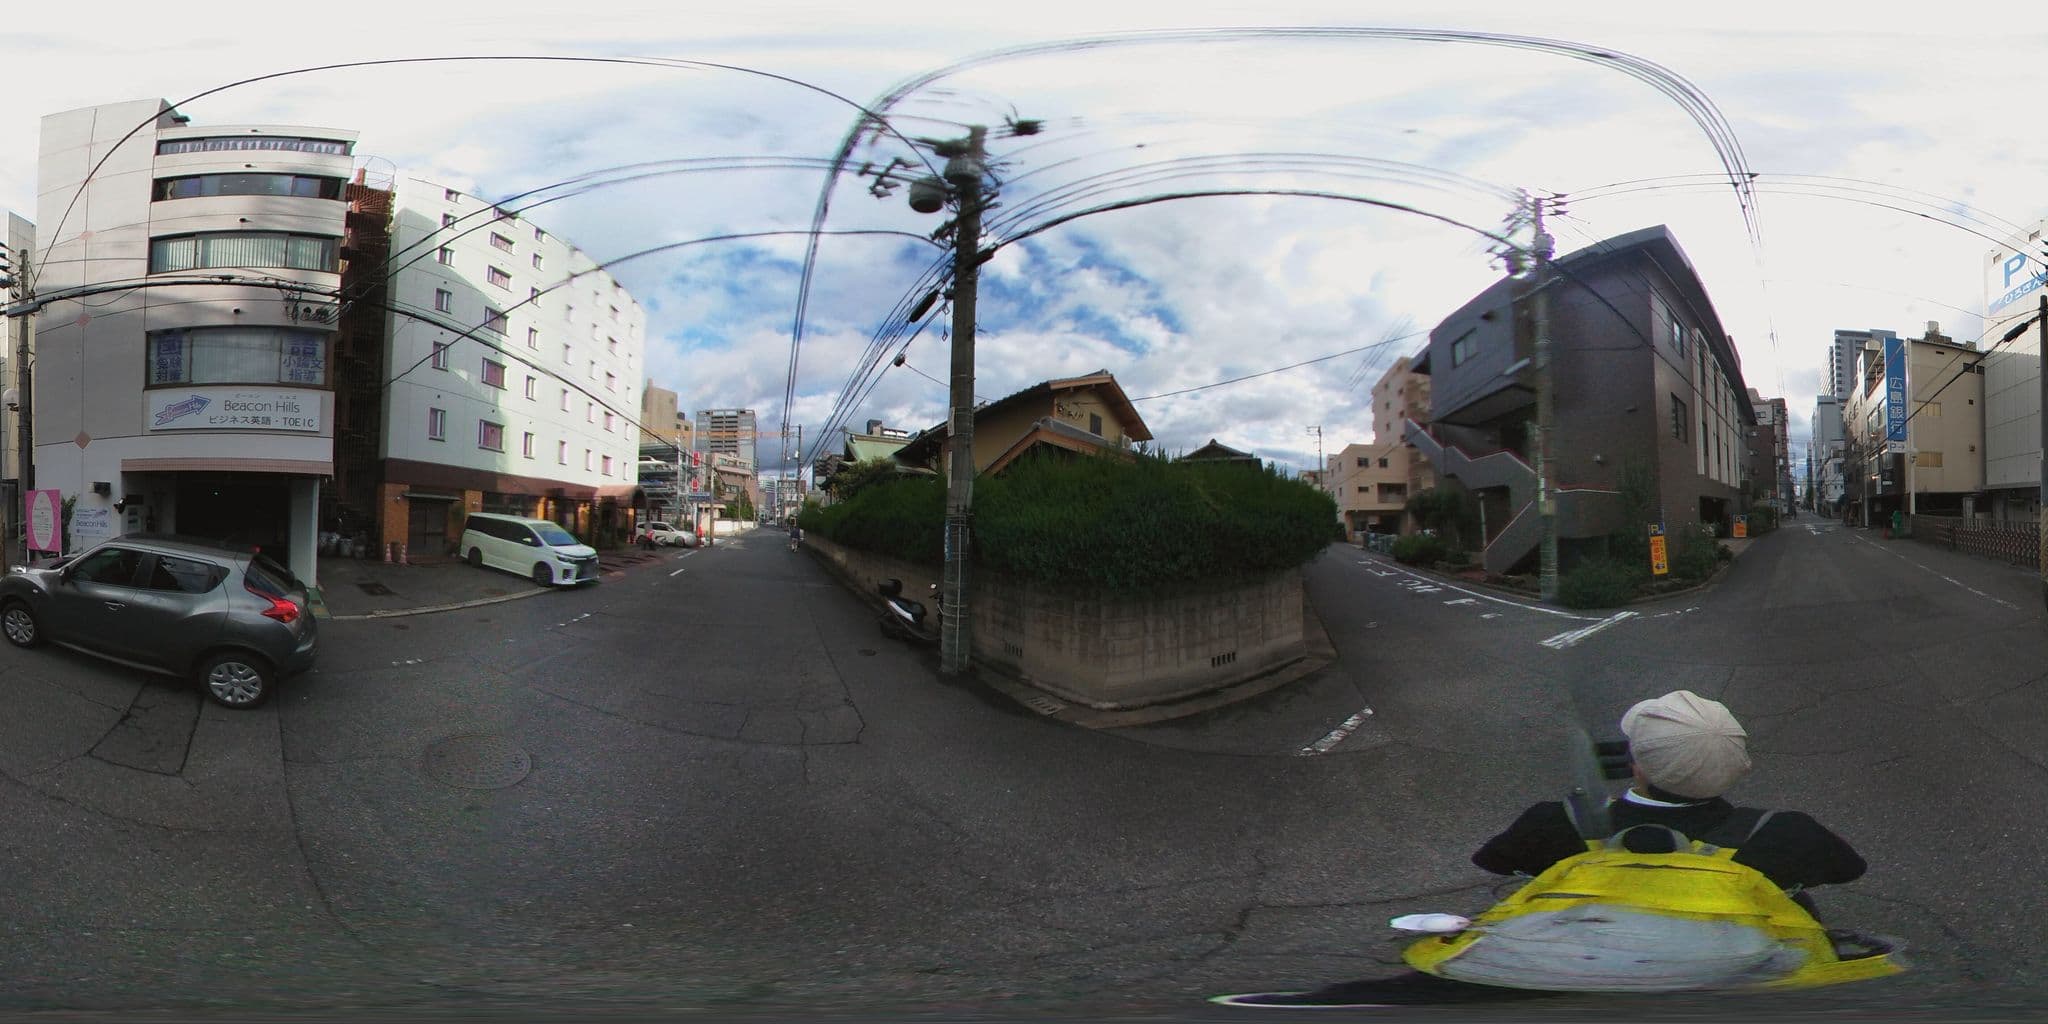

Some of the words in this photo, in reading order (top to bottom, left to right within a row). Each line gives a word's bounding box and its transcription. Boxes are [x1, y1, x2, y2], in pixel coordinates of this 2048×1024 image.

[2004, 253, 2027, 289] P
[224, 399, 272, 412] Beacon
[276, 400, 300, 413] Hills
[1889, 376, 1904, 434] 広島銀行
